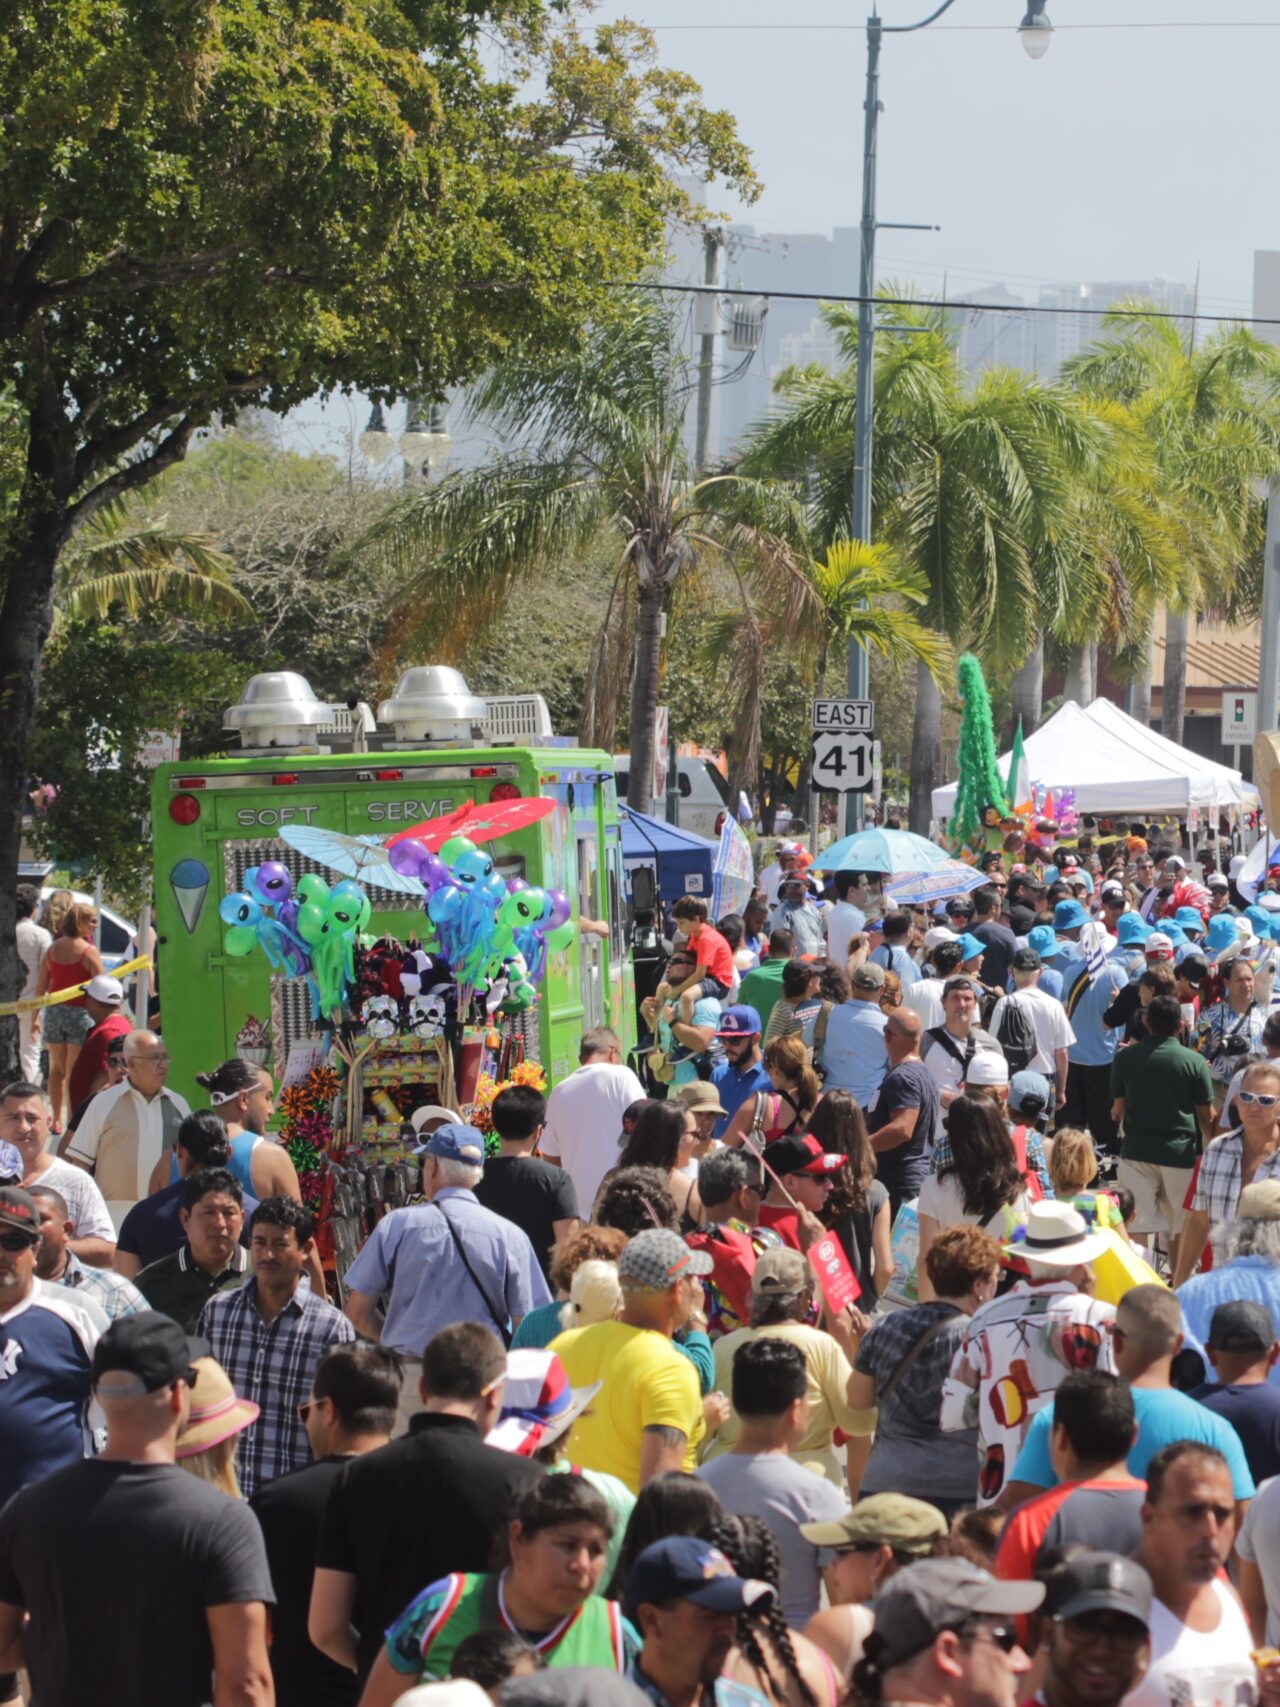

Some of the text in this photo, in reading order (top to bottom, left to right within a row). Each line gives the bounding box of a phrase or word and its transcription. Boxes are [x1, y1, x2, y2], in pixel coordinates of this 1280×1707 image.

[816, 704, 868, 725] EAST
[819, 745, 865, 777] 41
[236, 799, 454, 826] SOFT SERVE
